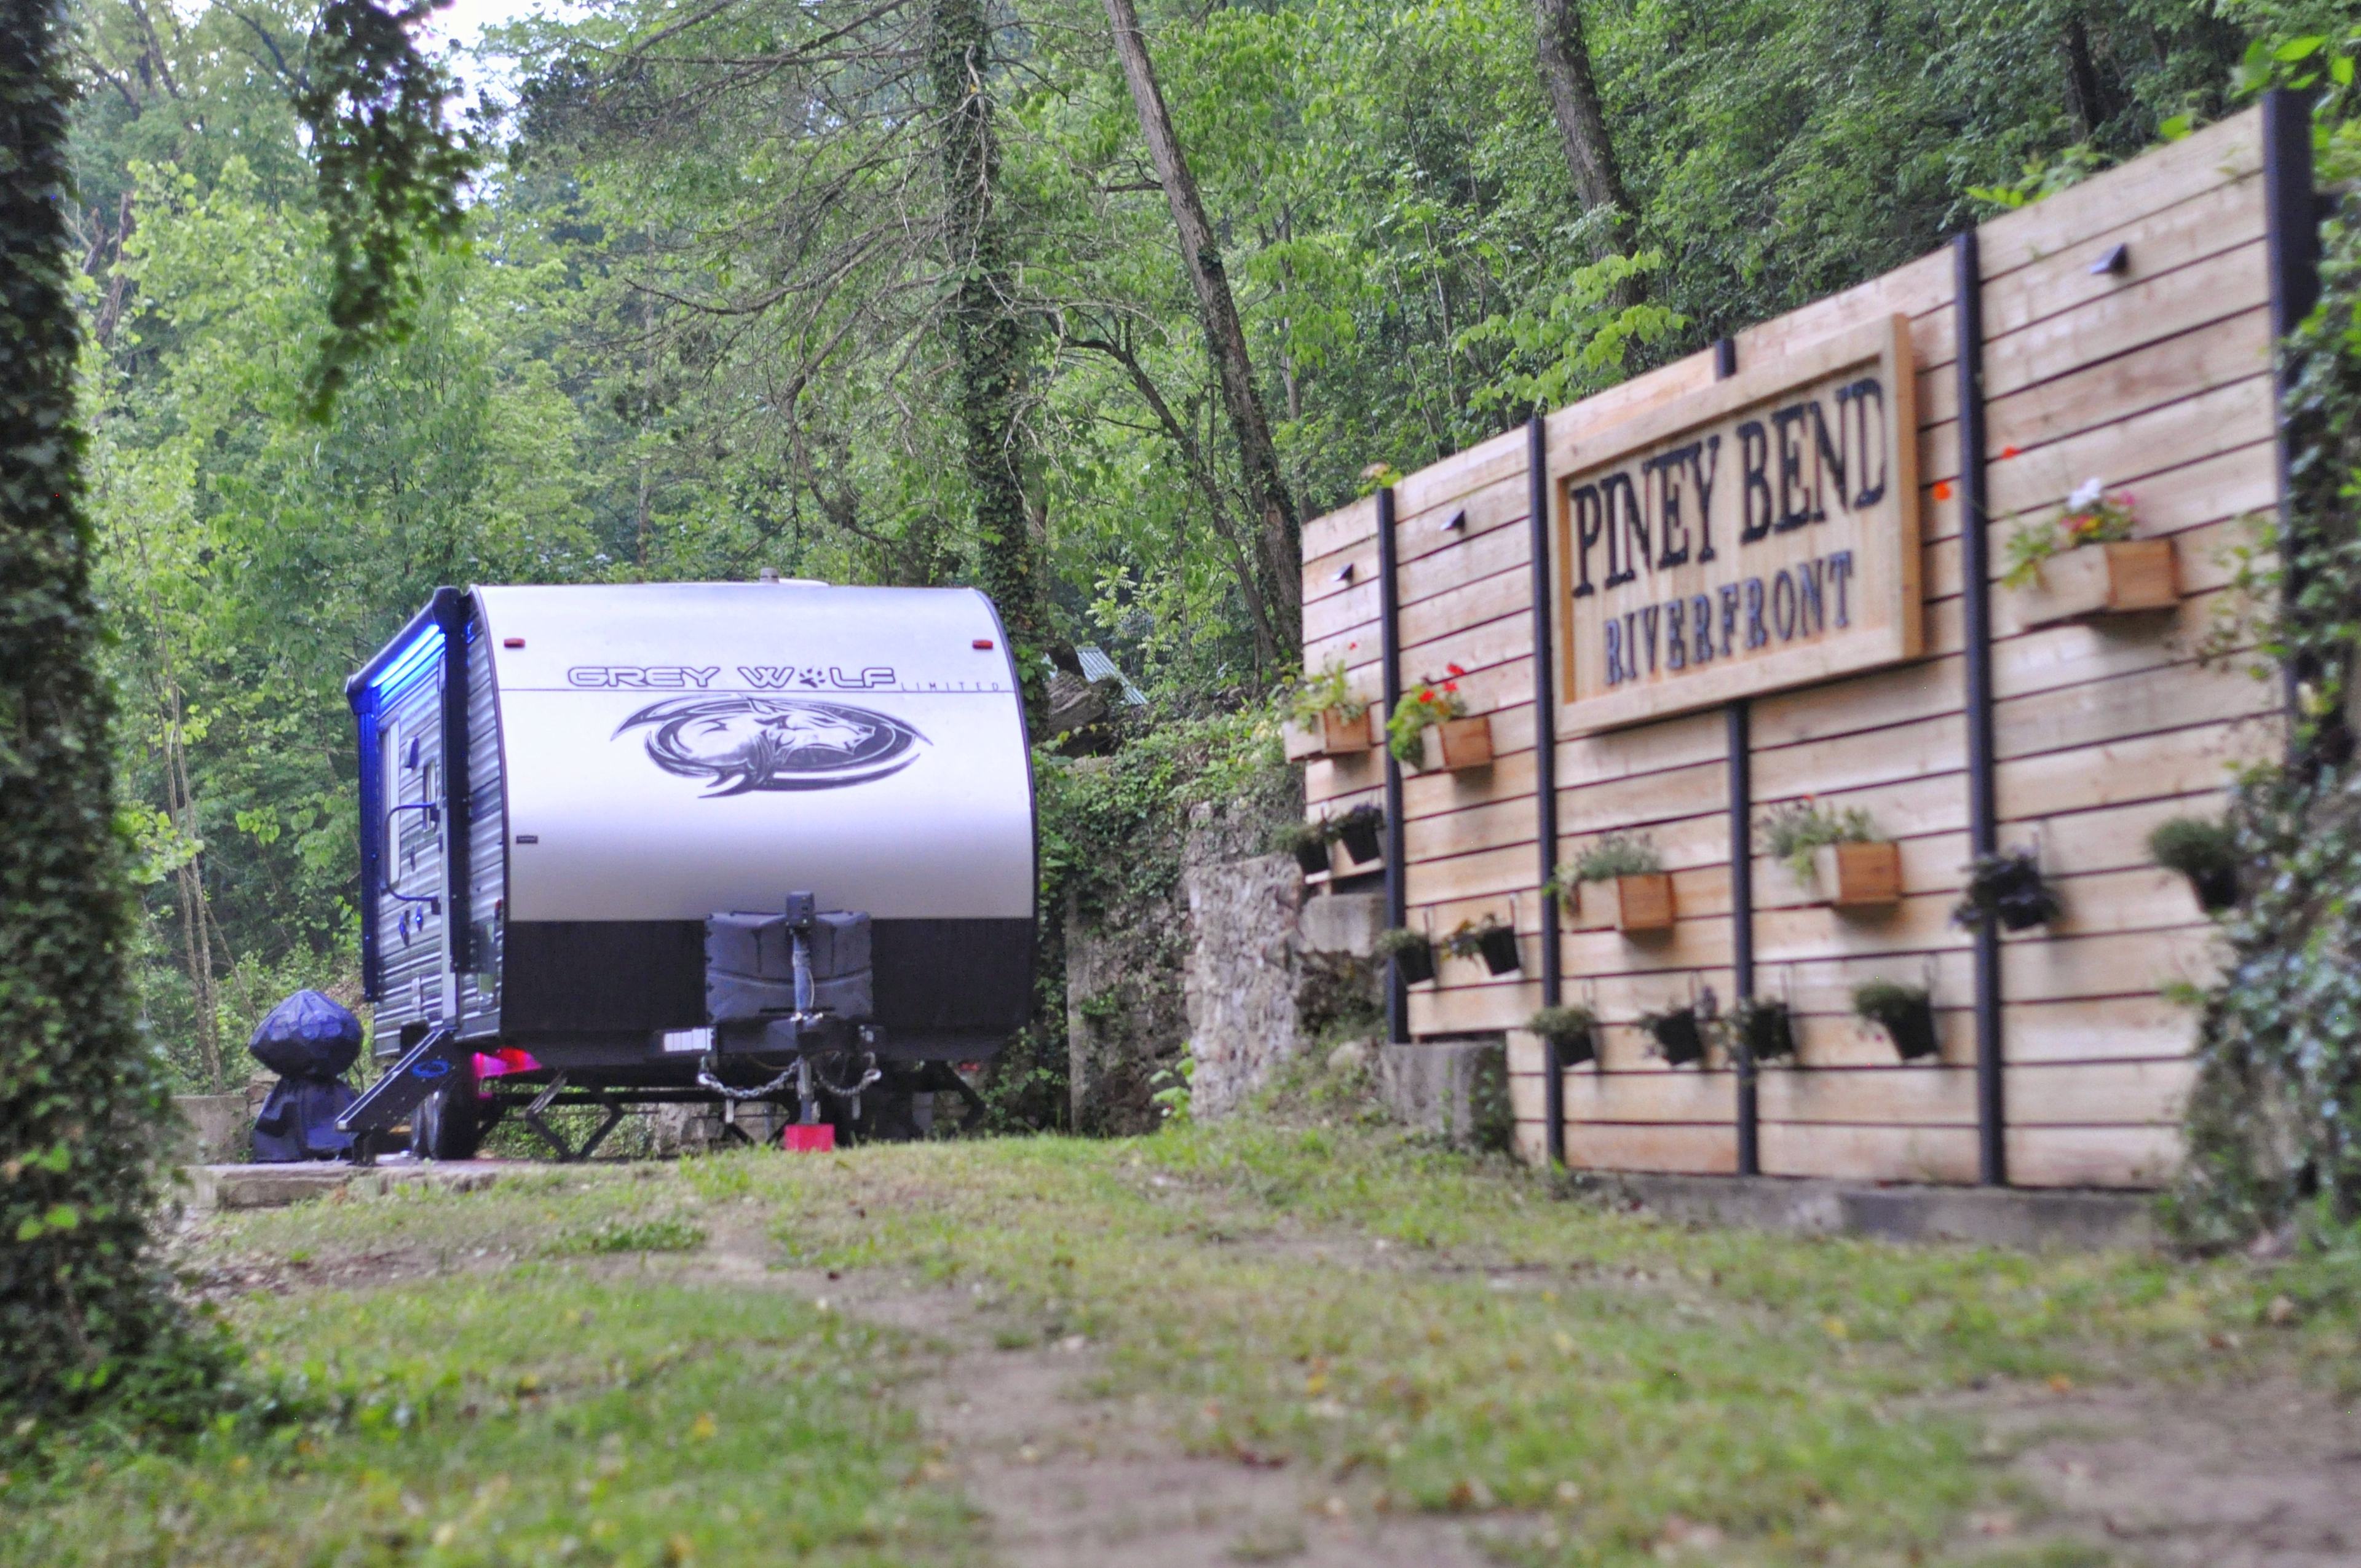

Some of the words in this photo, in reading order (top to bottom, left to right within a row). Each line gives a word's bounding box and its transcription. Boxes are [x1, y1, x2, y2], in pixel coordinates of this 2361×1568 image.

[1570, 435, 1720, 598] PINEY
[1737, 378, 1885, 545] BEND
[1605, 550, 1854, 685] RIVERFRONT
[568, 666, 720, 687] GREY
[901, 681, 999, 692] LIMITED
